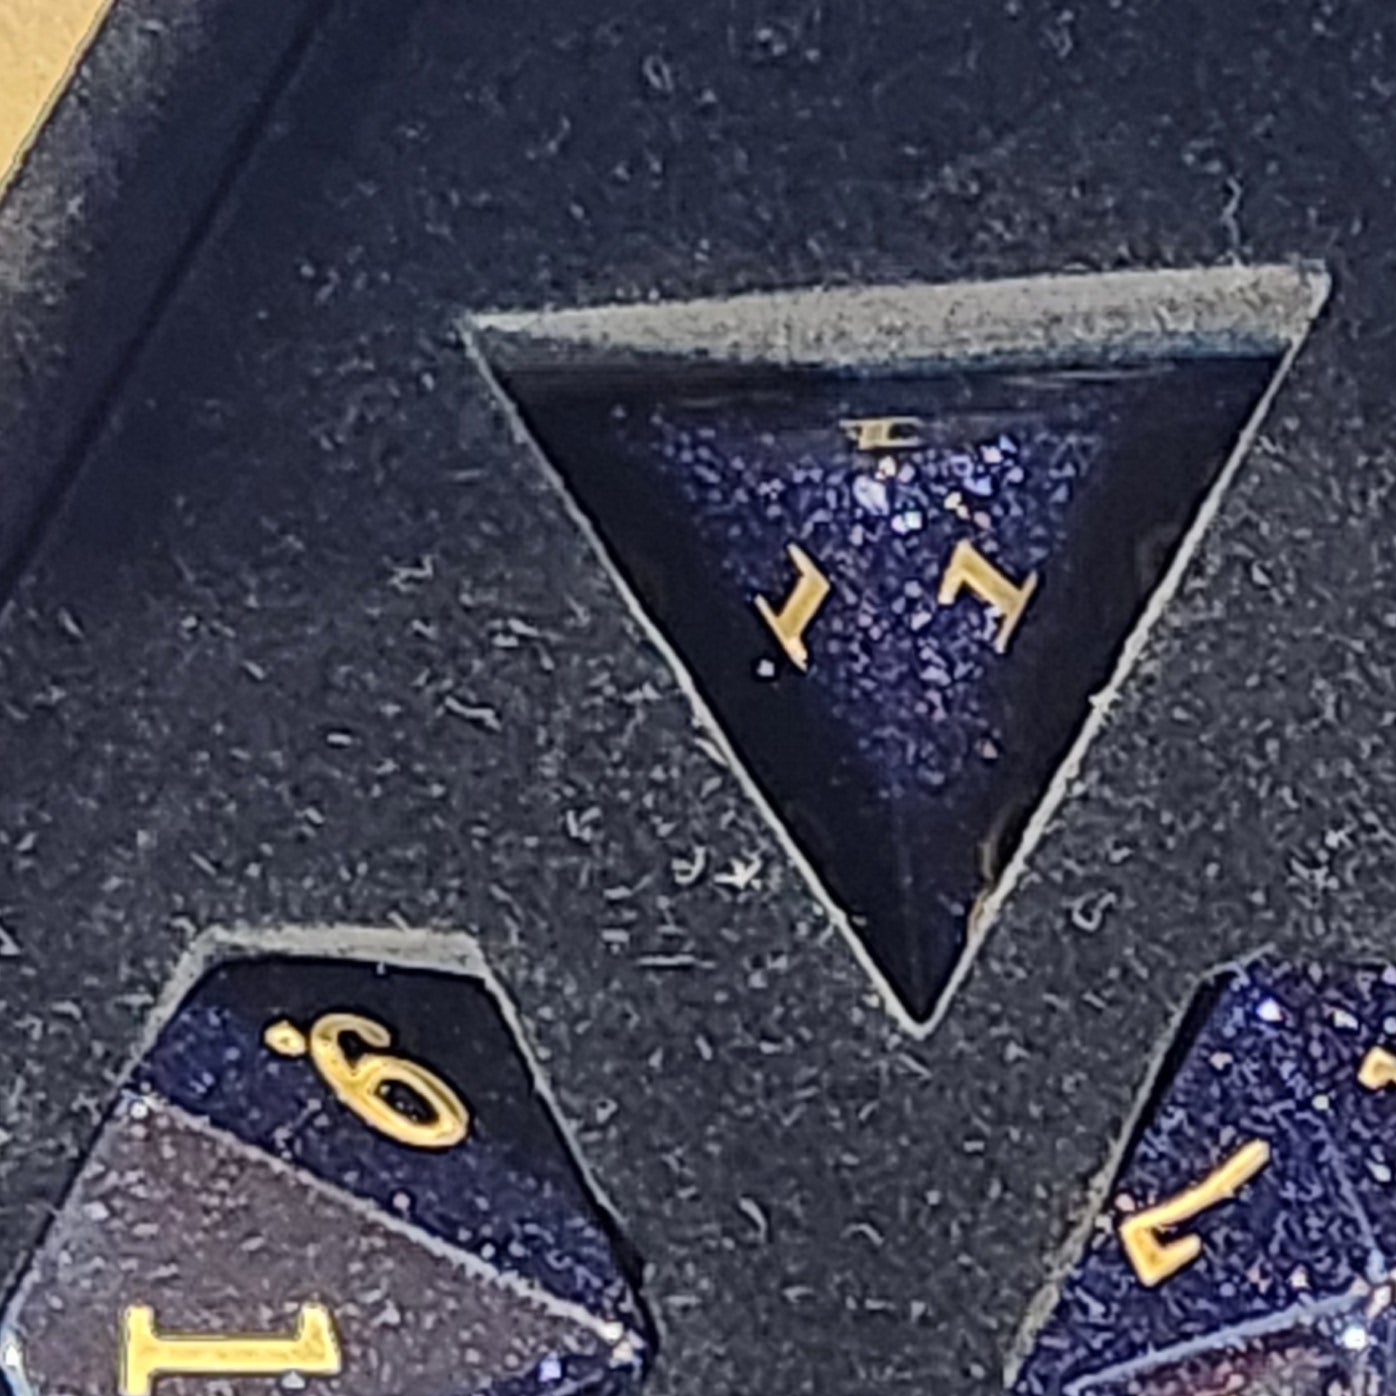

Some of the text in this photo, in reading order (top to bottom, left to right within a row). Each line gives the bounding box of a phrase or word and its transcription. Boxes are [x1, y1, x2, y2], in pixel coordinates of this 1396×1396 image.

[755, 544, 830, 670] 1
[939, 540, 1038, 653] 1
[1118, 1140, 1270, 1288] 7
